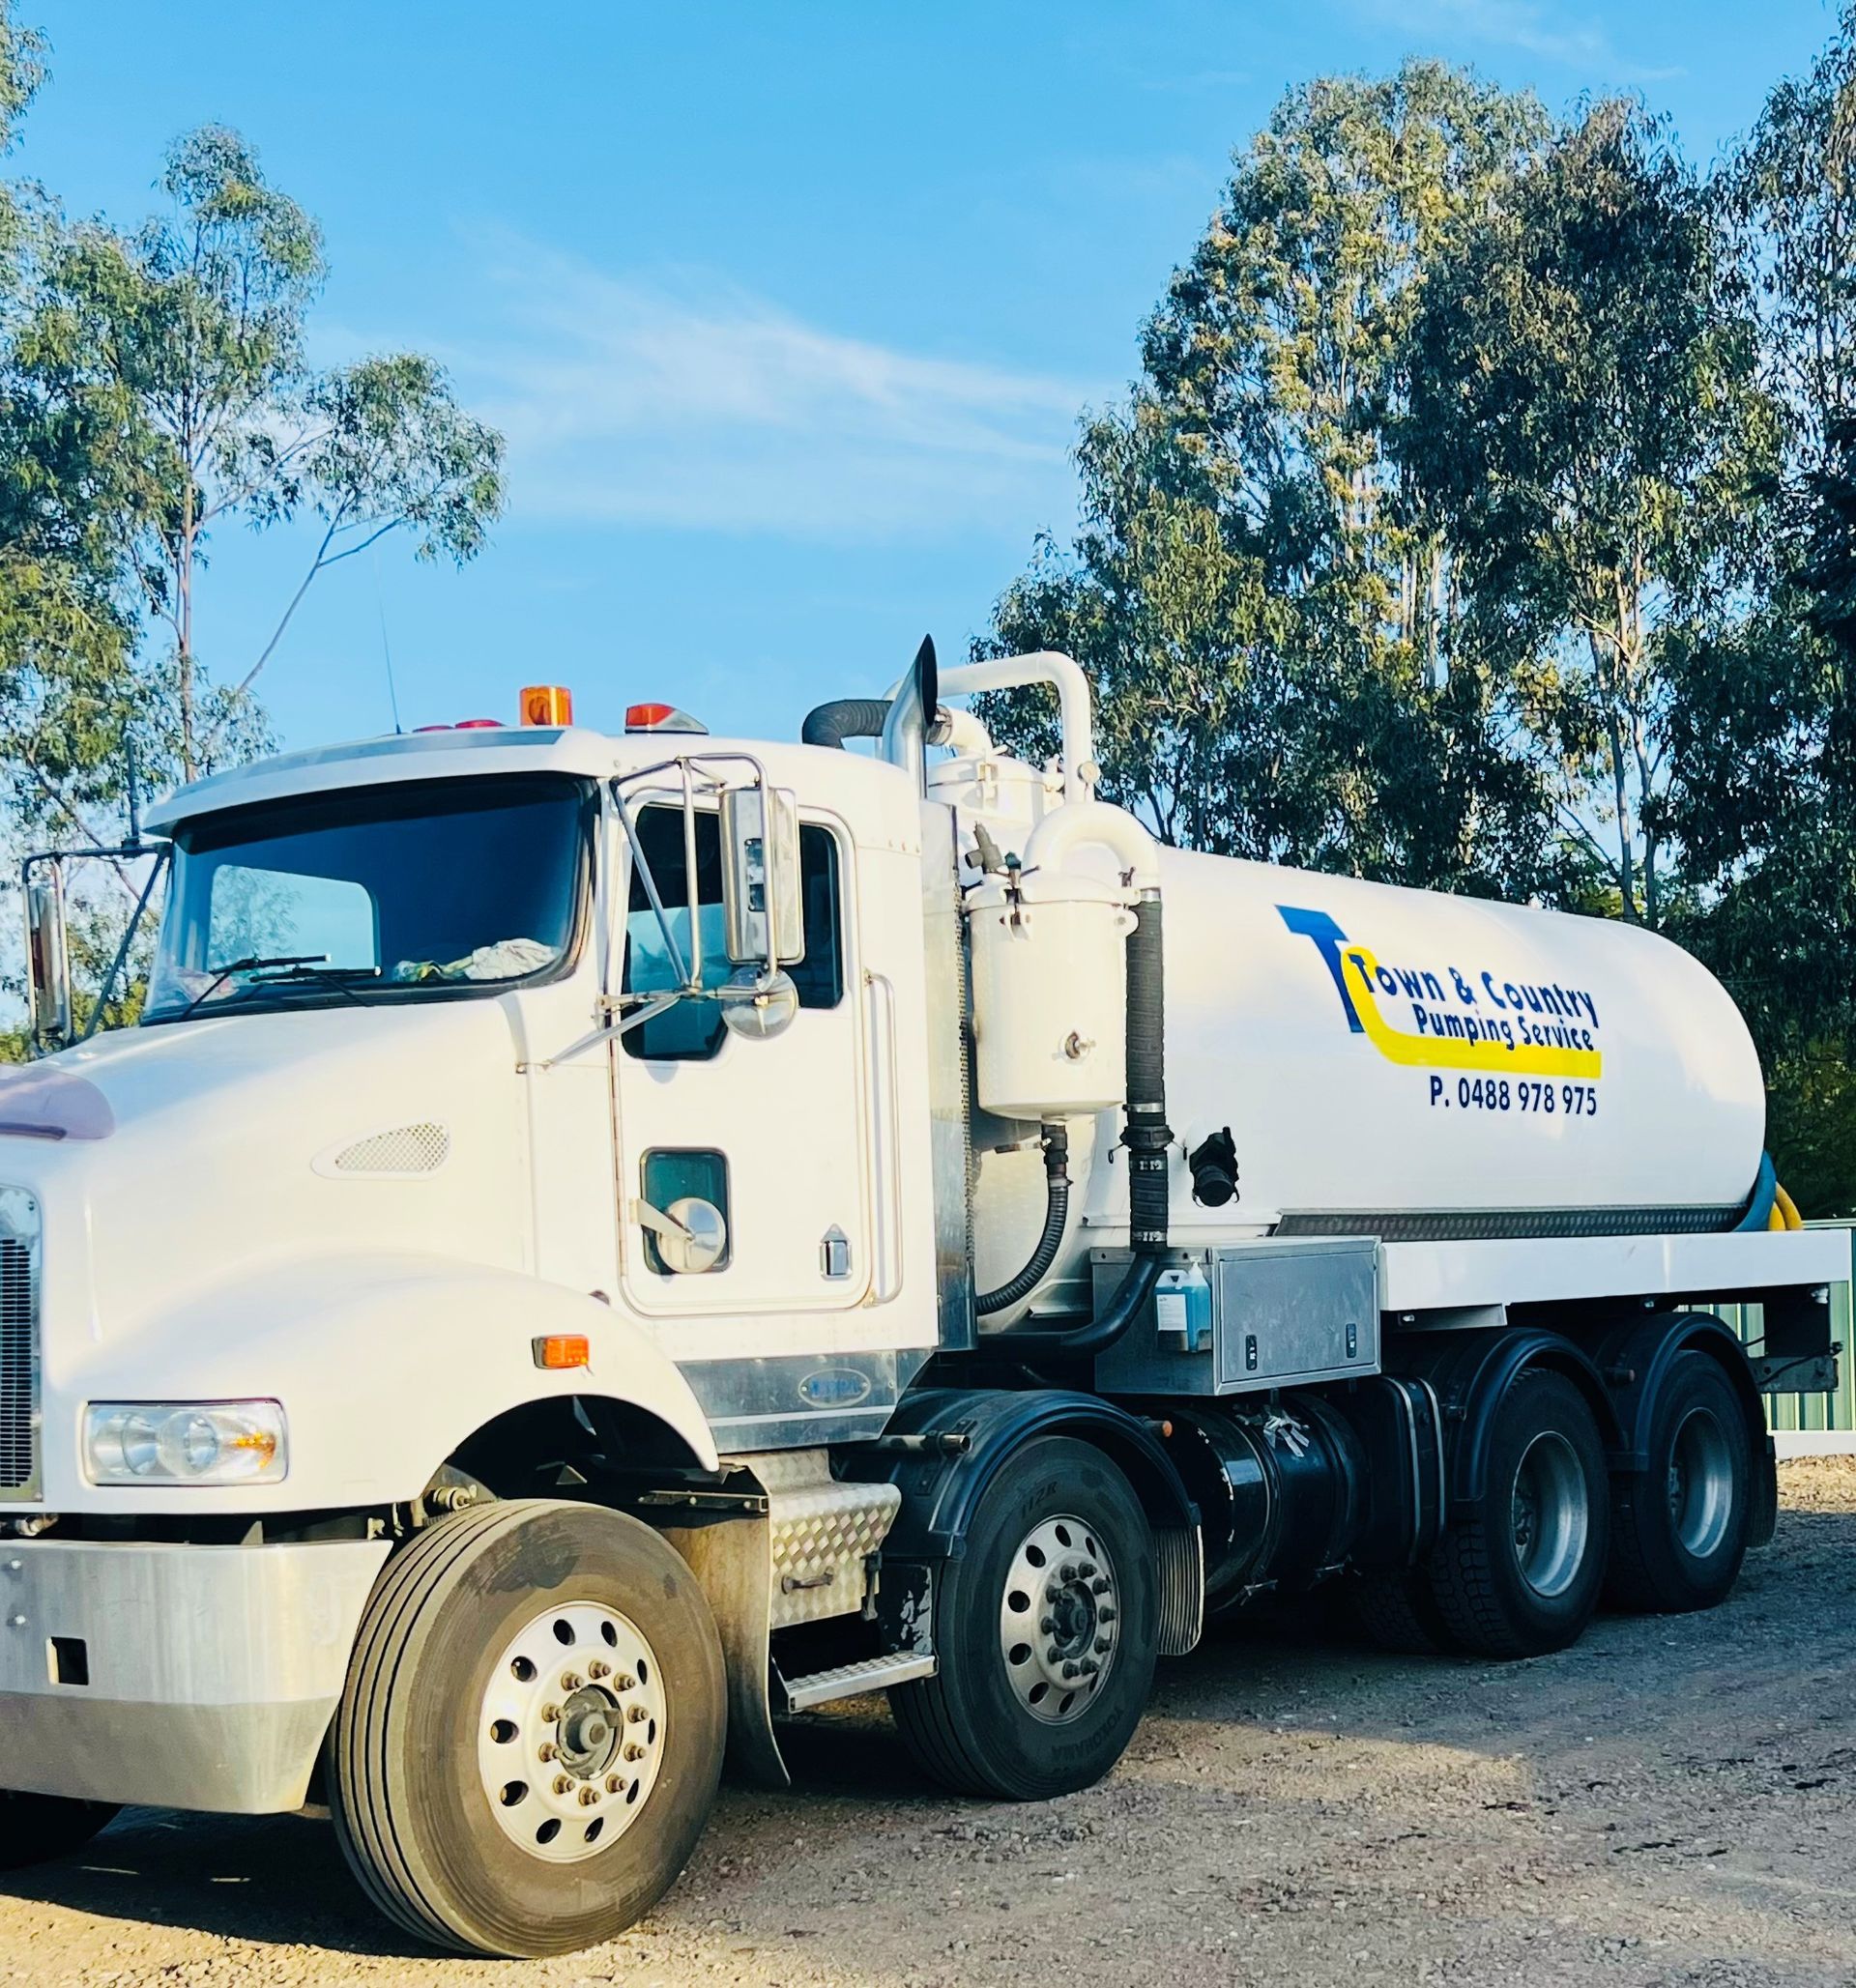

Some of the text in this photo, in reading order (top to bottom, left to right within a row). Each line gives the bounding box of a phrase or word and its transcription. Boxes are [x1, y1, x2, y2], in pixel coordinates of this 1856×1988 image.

[1348, 953, 1599, 1028] Town & Country
[1411, 1003, 1594, 1051] Pumping Service
[1430, 1075, 1597, 1116] P. 0488 978 975
